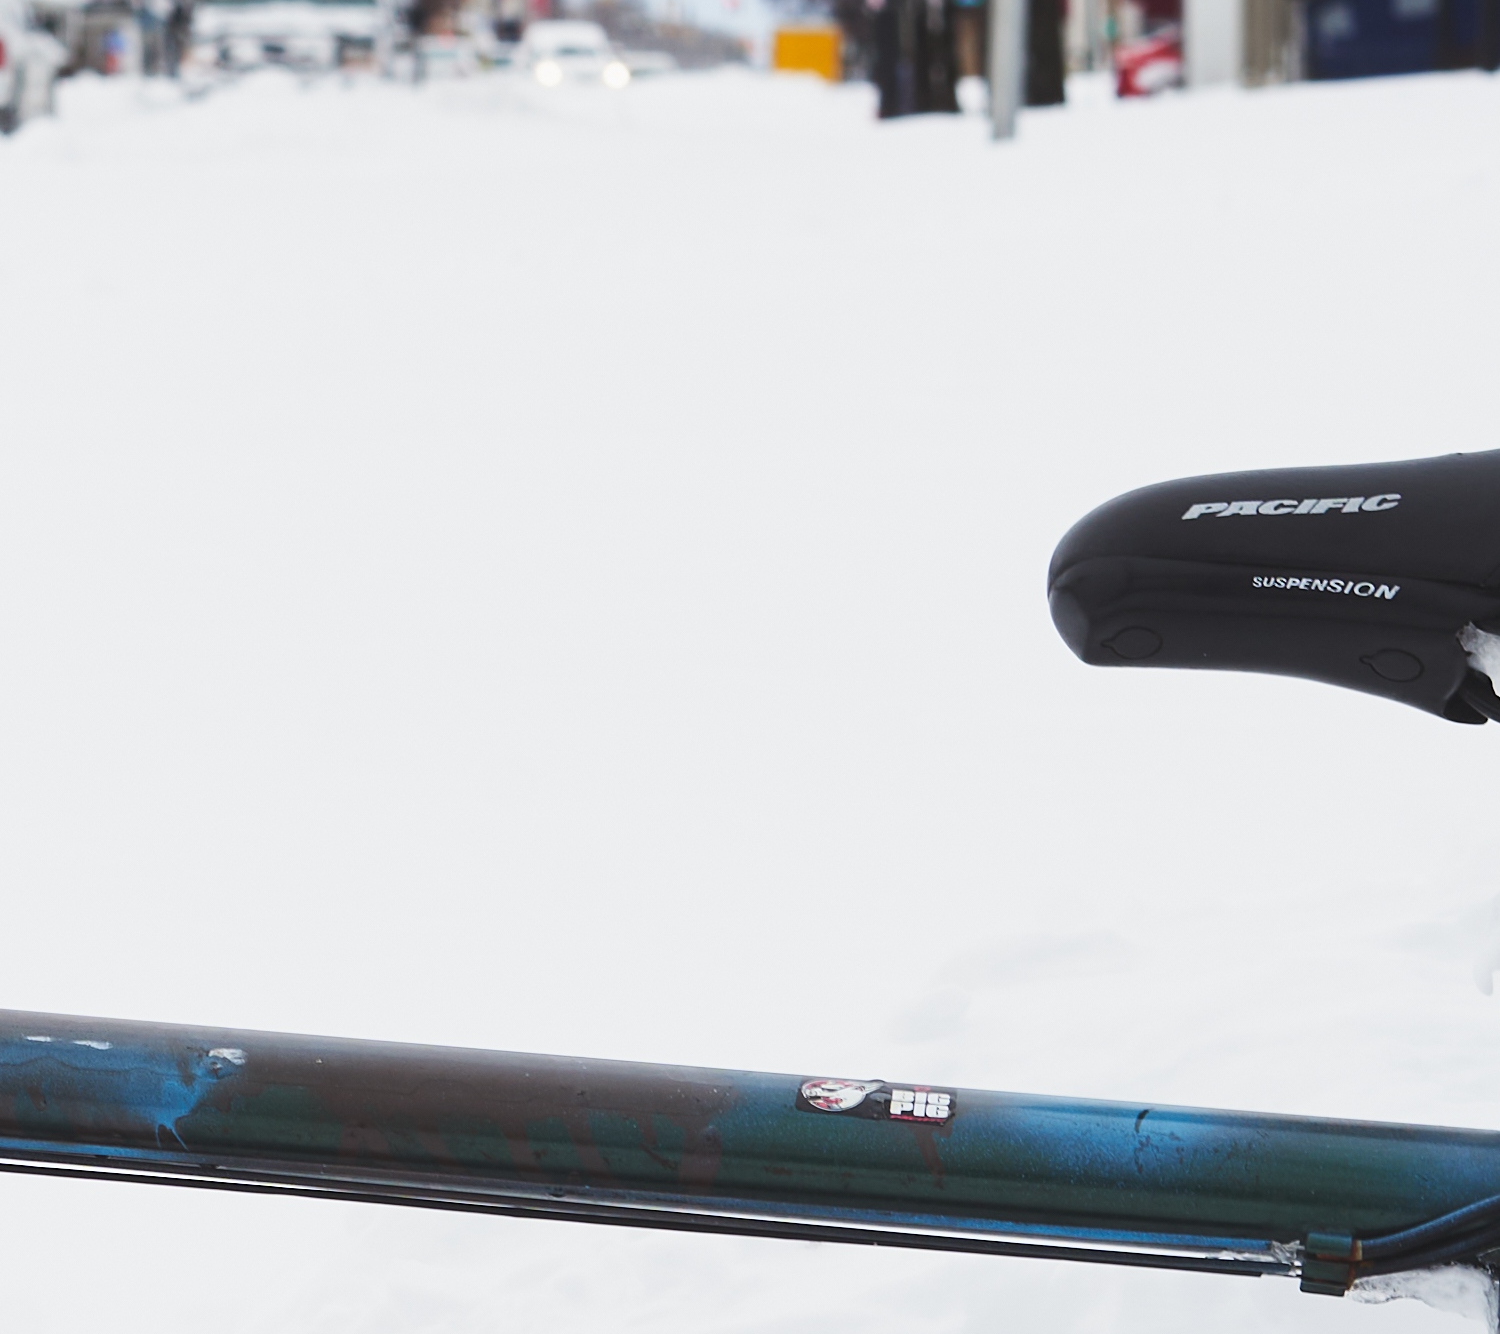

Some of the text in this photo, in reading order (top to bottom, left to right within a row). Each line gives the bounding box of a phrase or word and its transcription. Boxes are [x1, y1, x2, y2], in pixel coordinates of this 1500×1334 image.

[1181, 493, 1402, 520] PACIFIC
[1252, 576, 1400, 600] SUSPENSION
[890, 1100, 949, 1118] PIG
